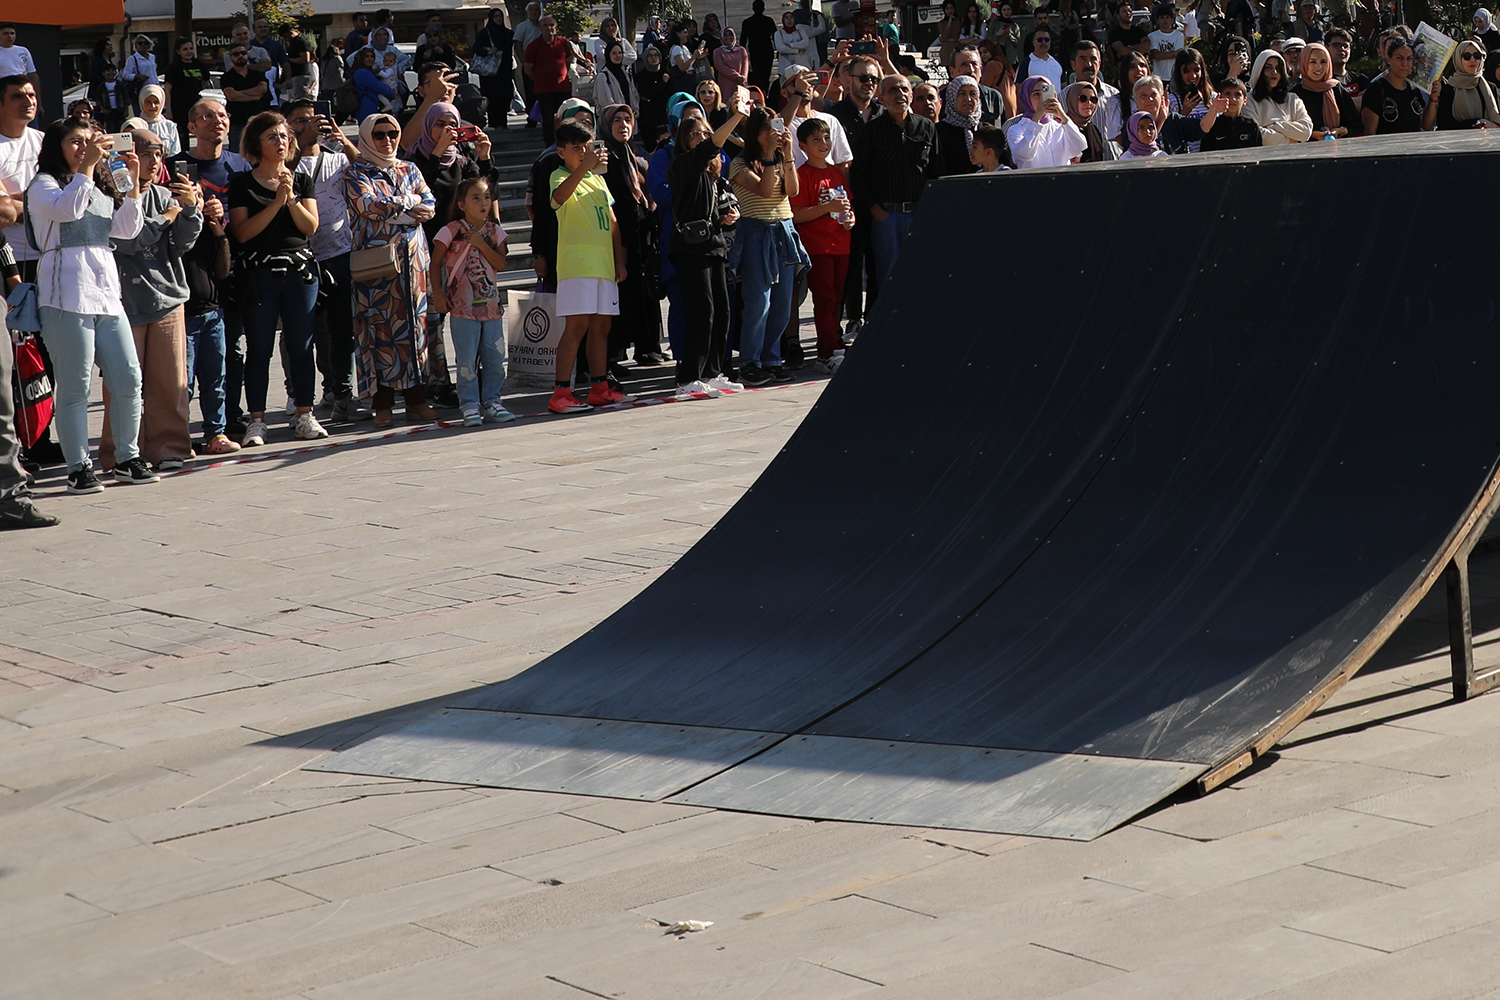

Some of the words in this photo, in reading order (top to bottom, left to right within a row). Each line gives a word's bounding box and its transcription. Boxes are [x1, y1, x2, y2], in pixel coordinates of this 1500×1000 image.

[594, 205, 610, 231] 10
[508, 344, 535, 355] EYHAN
[512, 357, 554, 367] KİTABEVİ
